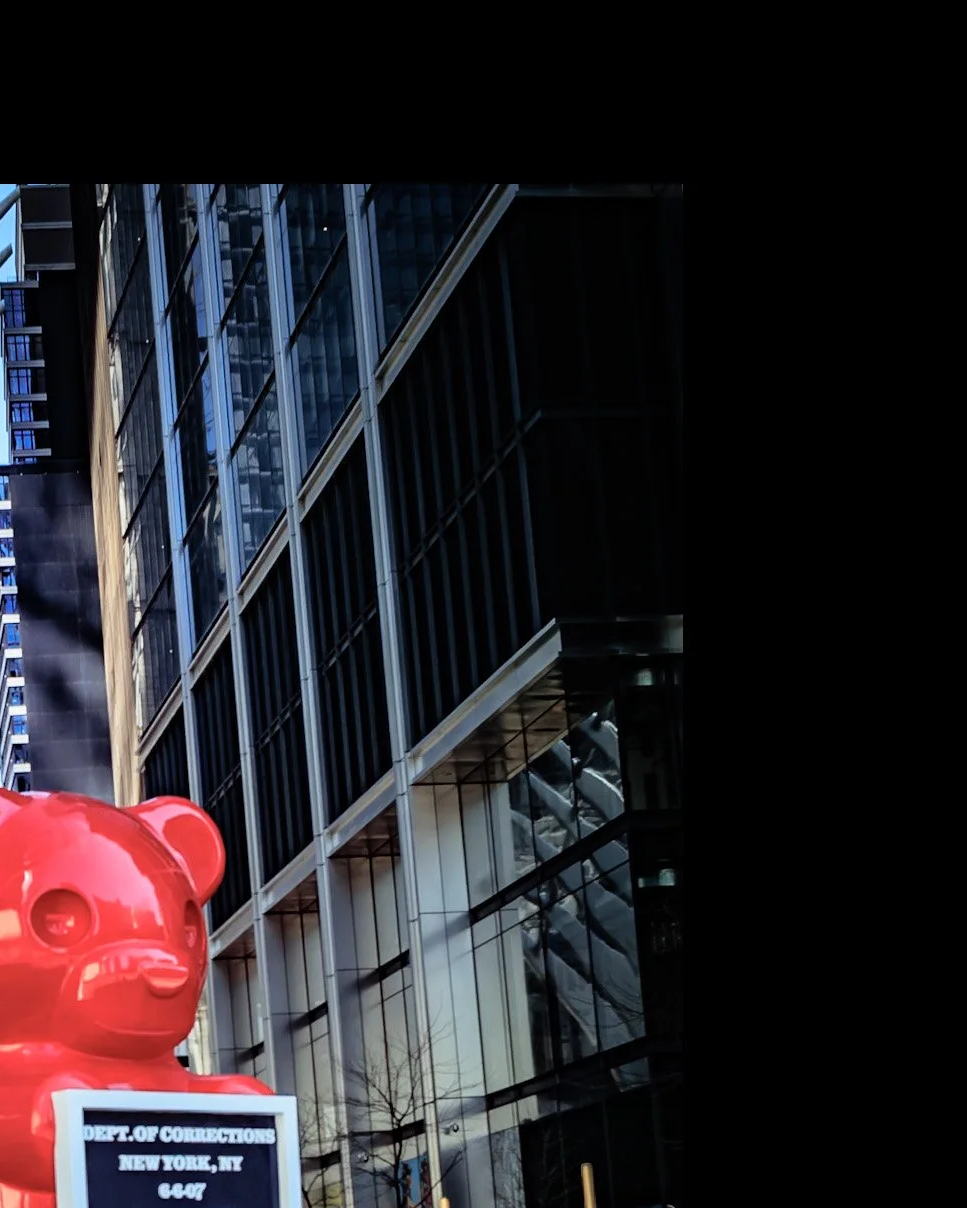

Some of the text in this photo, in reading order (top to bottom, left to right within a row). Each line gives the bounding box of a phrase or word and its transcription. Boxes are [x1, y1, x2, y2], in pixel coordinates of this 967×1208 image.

[133, 1125, 159, 1143] OF
[159, 1126, 276, 1145] CORRECTIONS
[118, 1154, 244, 1174] NEW YORK, NY
